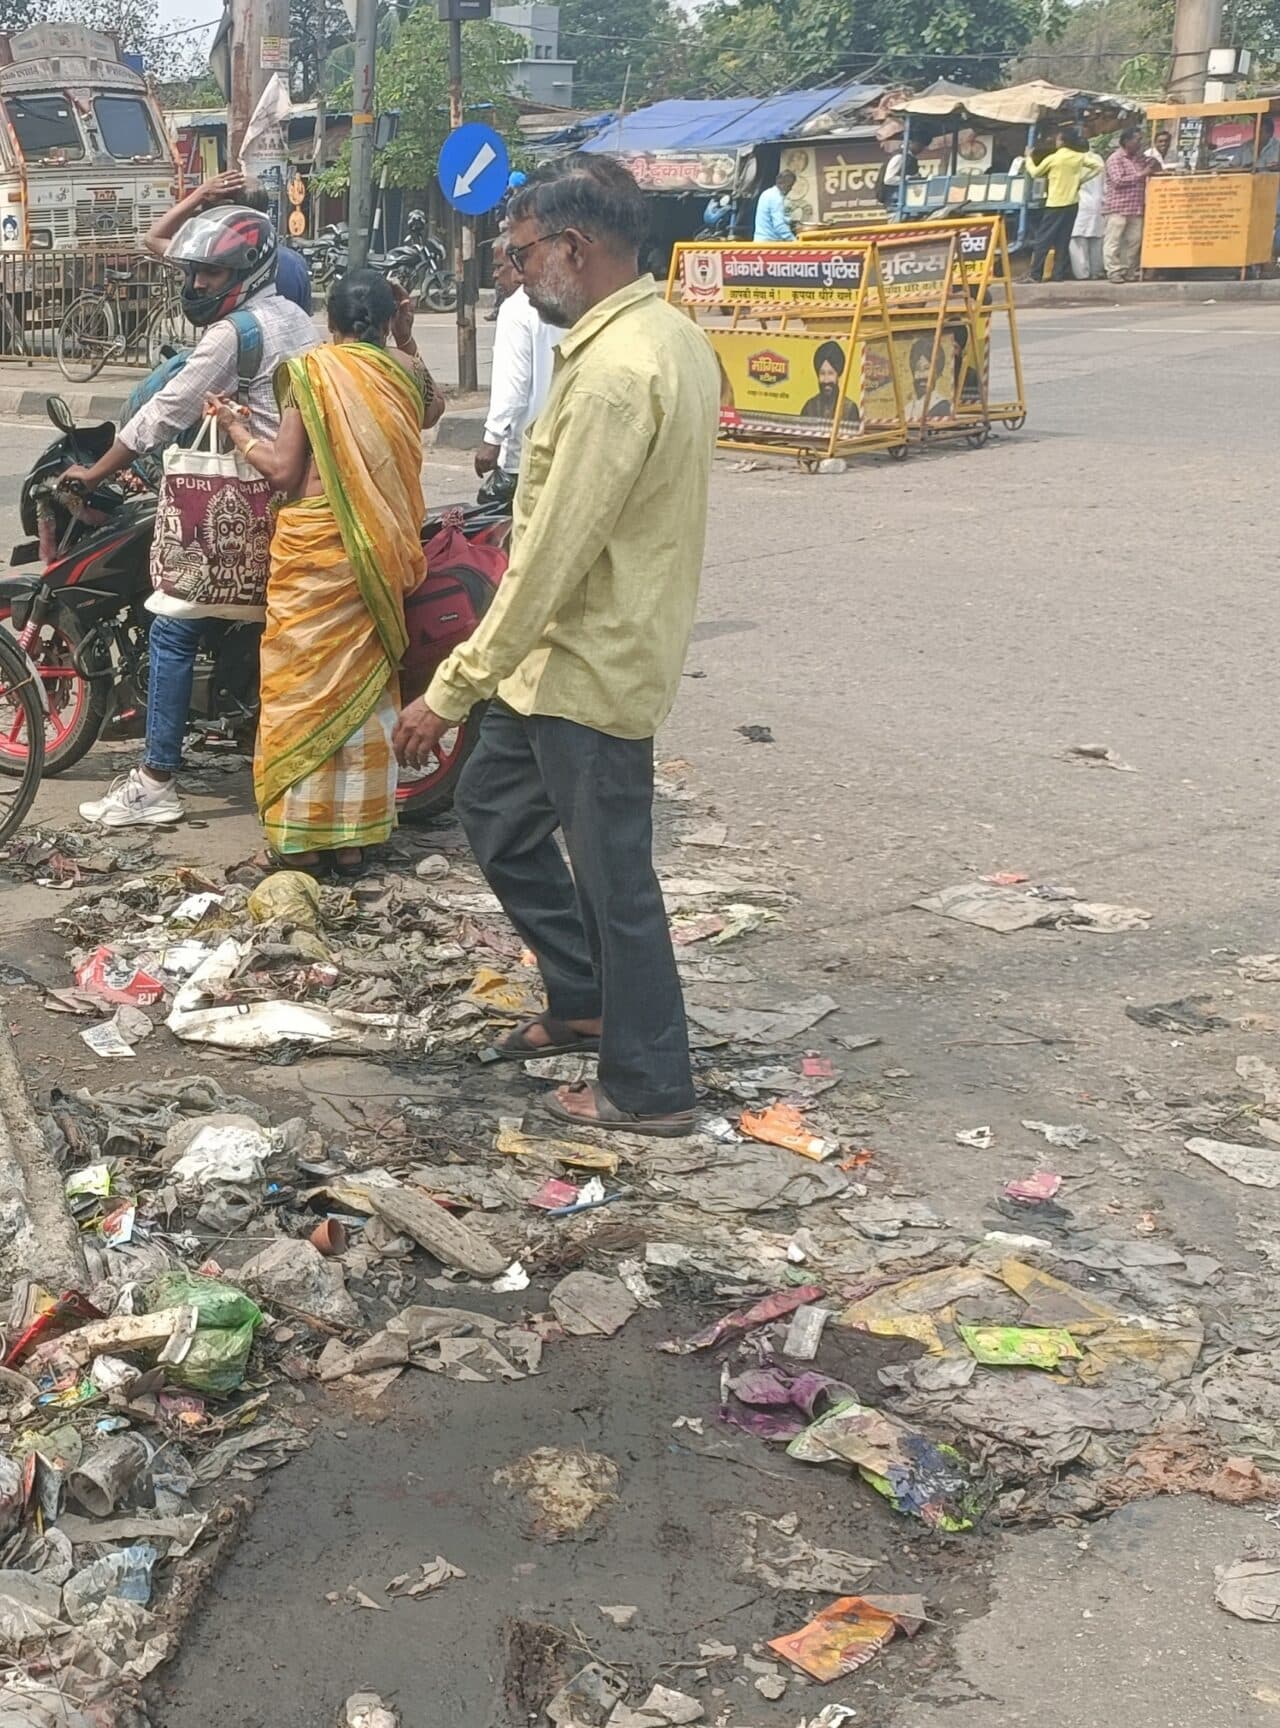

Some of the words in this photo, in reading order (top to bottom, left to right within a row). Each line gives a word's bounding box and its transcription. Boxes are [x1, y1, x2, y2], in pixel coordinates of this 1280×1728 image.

[93, 190, 117, 200] TATA
[724, 255, 765, 278] बोकारो
[766, 261, 820, 278] यातायात
[821, 255, 860, 286] पुलिस
[176, 477, 212, 491] PURI
